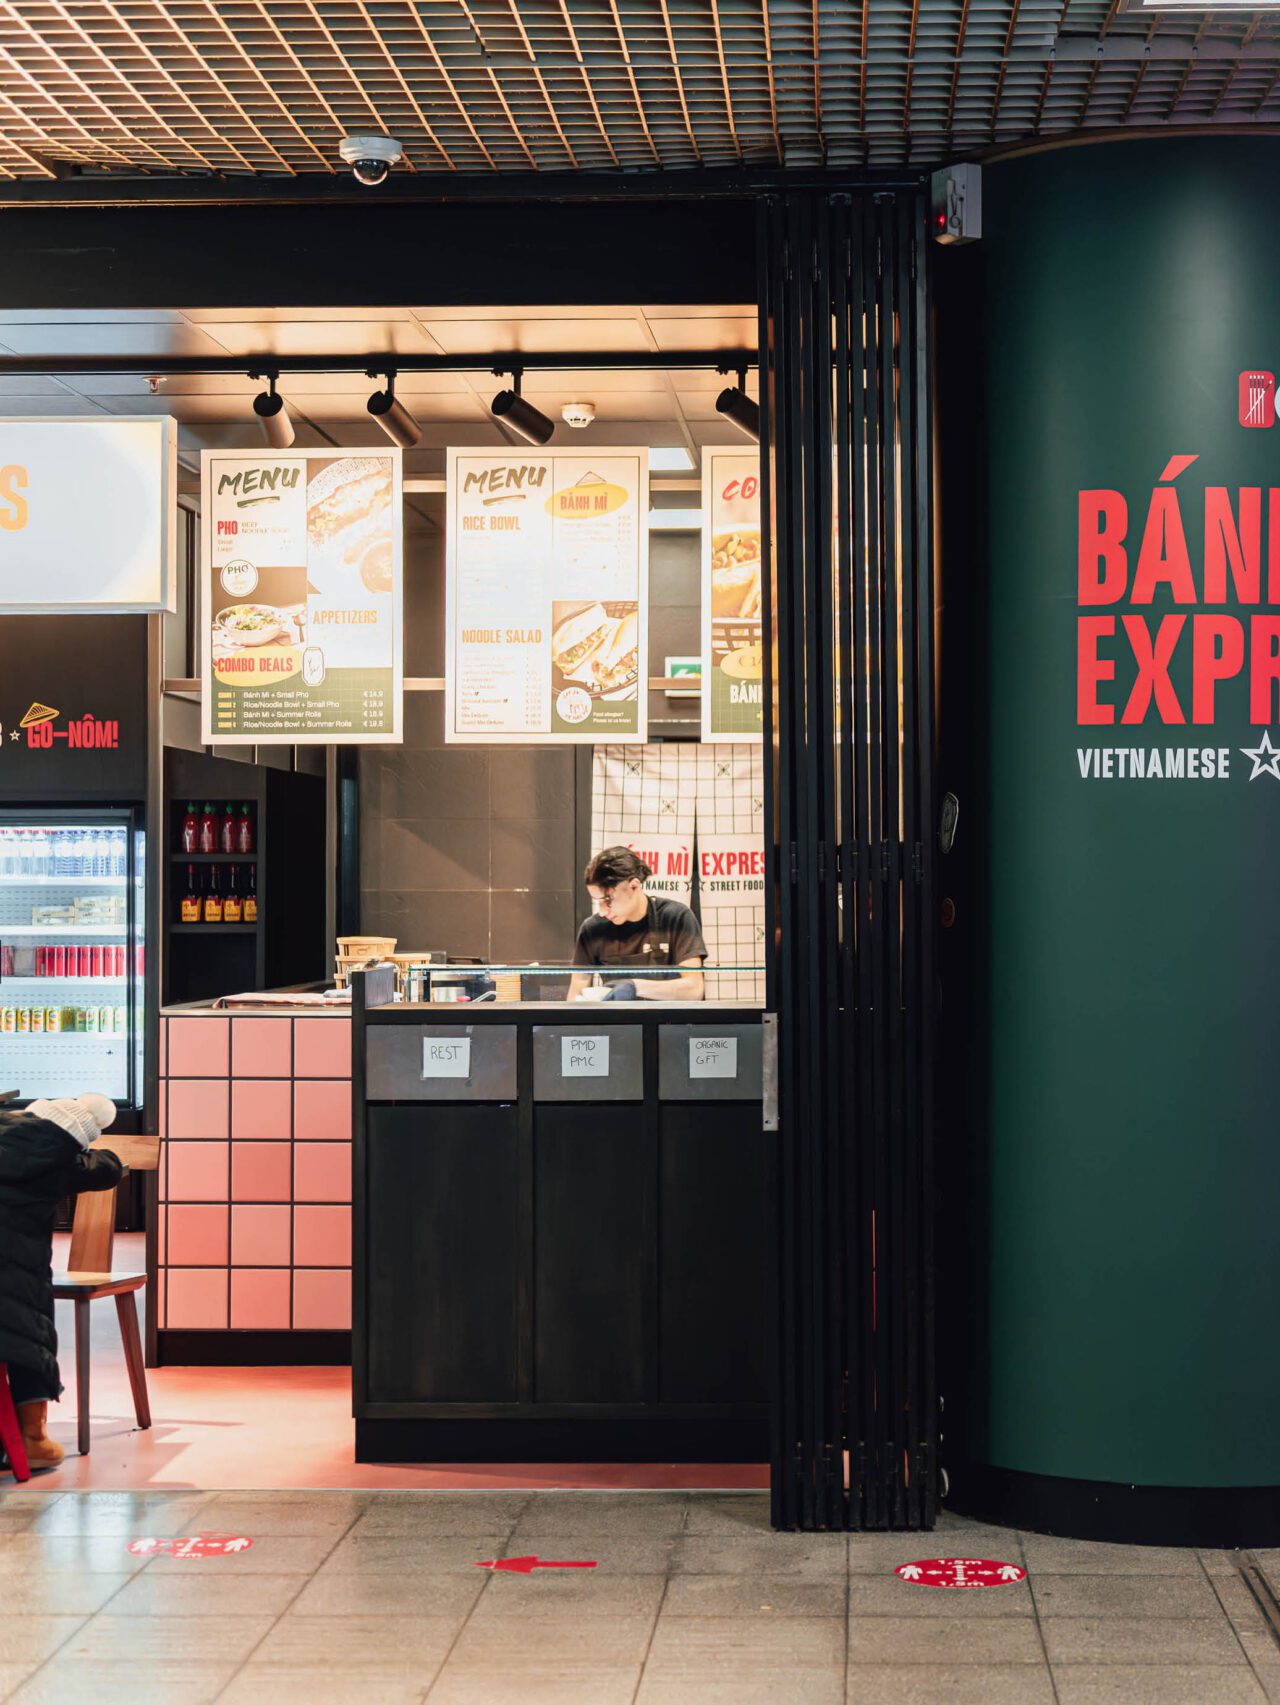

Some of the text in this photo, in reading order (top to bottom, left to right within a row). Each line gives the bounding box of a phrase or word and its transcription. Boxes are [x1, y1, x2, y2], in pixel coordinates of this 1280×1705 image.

[218, 467, 300, 495] MENU
[463, 465, 547, 494] MENU
[217, 521, 238, 535] PHO
[463, 515, 521, 530] RICE BOWL
[313, 609, 378, 625] APPETIZERS
[462, 629, 542, 643] NOODLE SALAD
[217, 657, 293, 673] COMBO DEALS
[277, 691, 295, 699] Small
[284, 701, 300, 709] Bowl
[307, 701, 325, 709] Small
[1077, 748, 1230, 779] VIETNAMESE
[667, 846, 689, 876] MÌ
[710, 881, 740, 892] STREET
[743, 880, 764, 891] FOOD
[571, 1039, 596, 1051] PMD
[430, 1045, 463, 1060] REST
[570, 1056, 595, 1067] PMC
[696, 1055, 720, 1065] GFT
